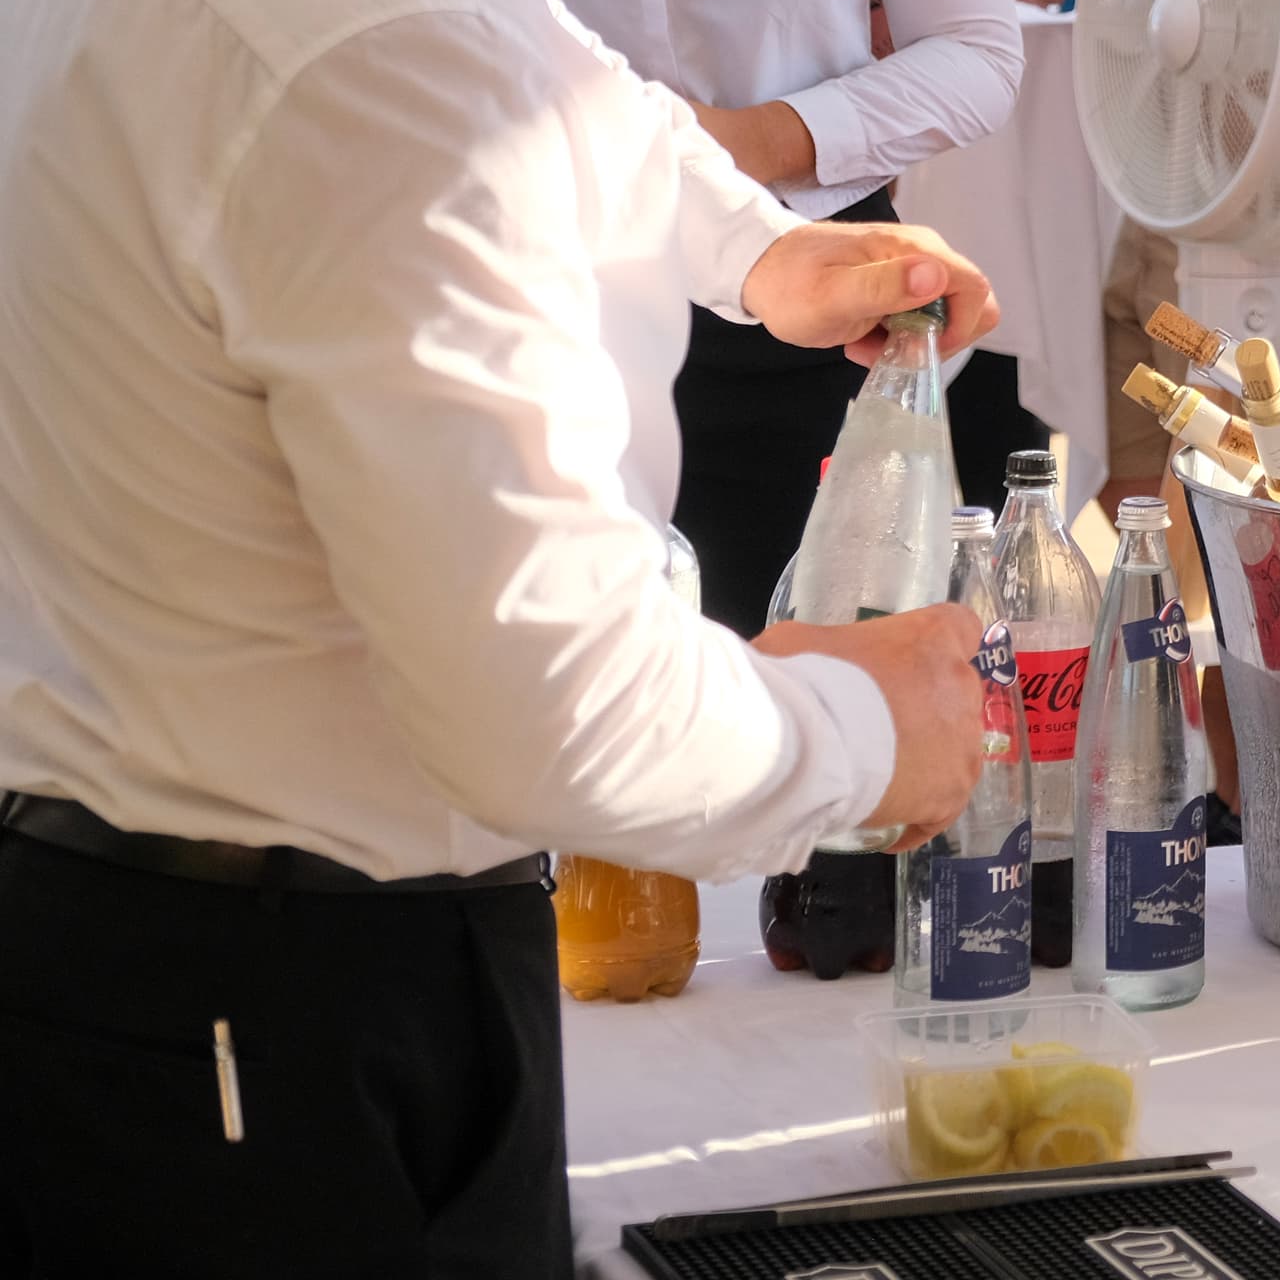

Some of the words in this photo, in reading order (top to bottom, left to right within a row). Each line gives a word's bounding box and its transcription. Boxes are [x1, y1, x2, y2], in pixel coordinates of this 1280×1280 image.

[1045, 721, 1077, 733] SUCR
[1161, 832, 1207, 867] THON
[1112, 1235, 1216, 1280] DIP
